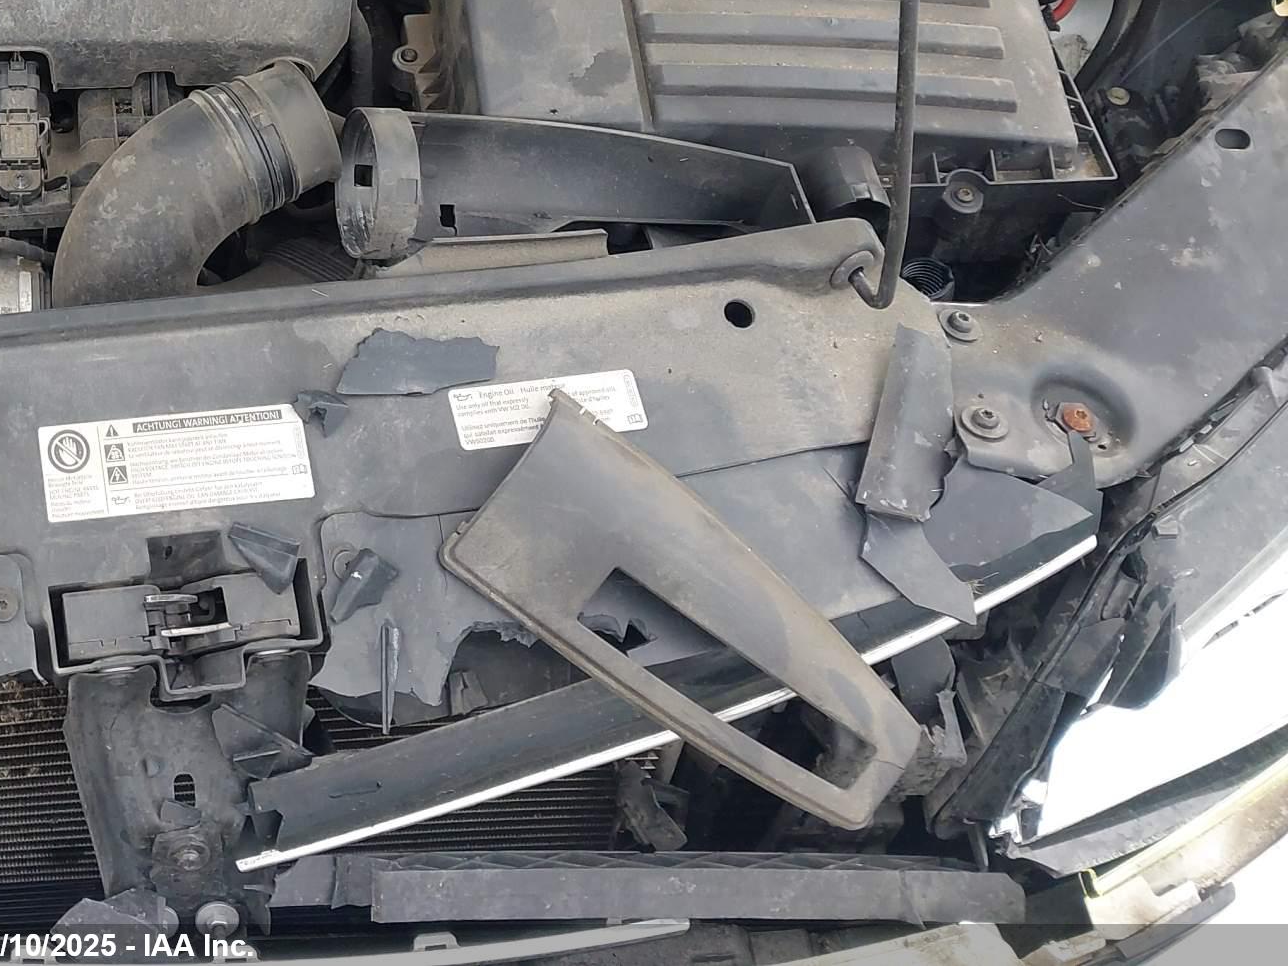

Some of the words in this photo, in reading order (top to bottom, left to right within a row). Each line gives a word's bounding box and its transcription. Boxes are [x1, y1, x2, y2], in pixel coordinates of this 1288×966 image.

[478, 389, 503, 400] Engine
[503, 387, 514, 395] Oil
[519, 384, 539, 393] Huile
[135, 418, 181, 432] ACHTUNG!
[182, 414, 227, 428] WARNING!
[228, 409, 280, 423] ATTENTION!
